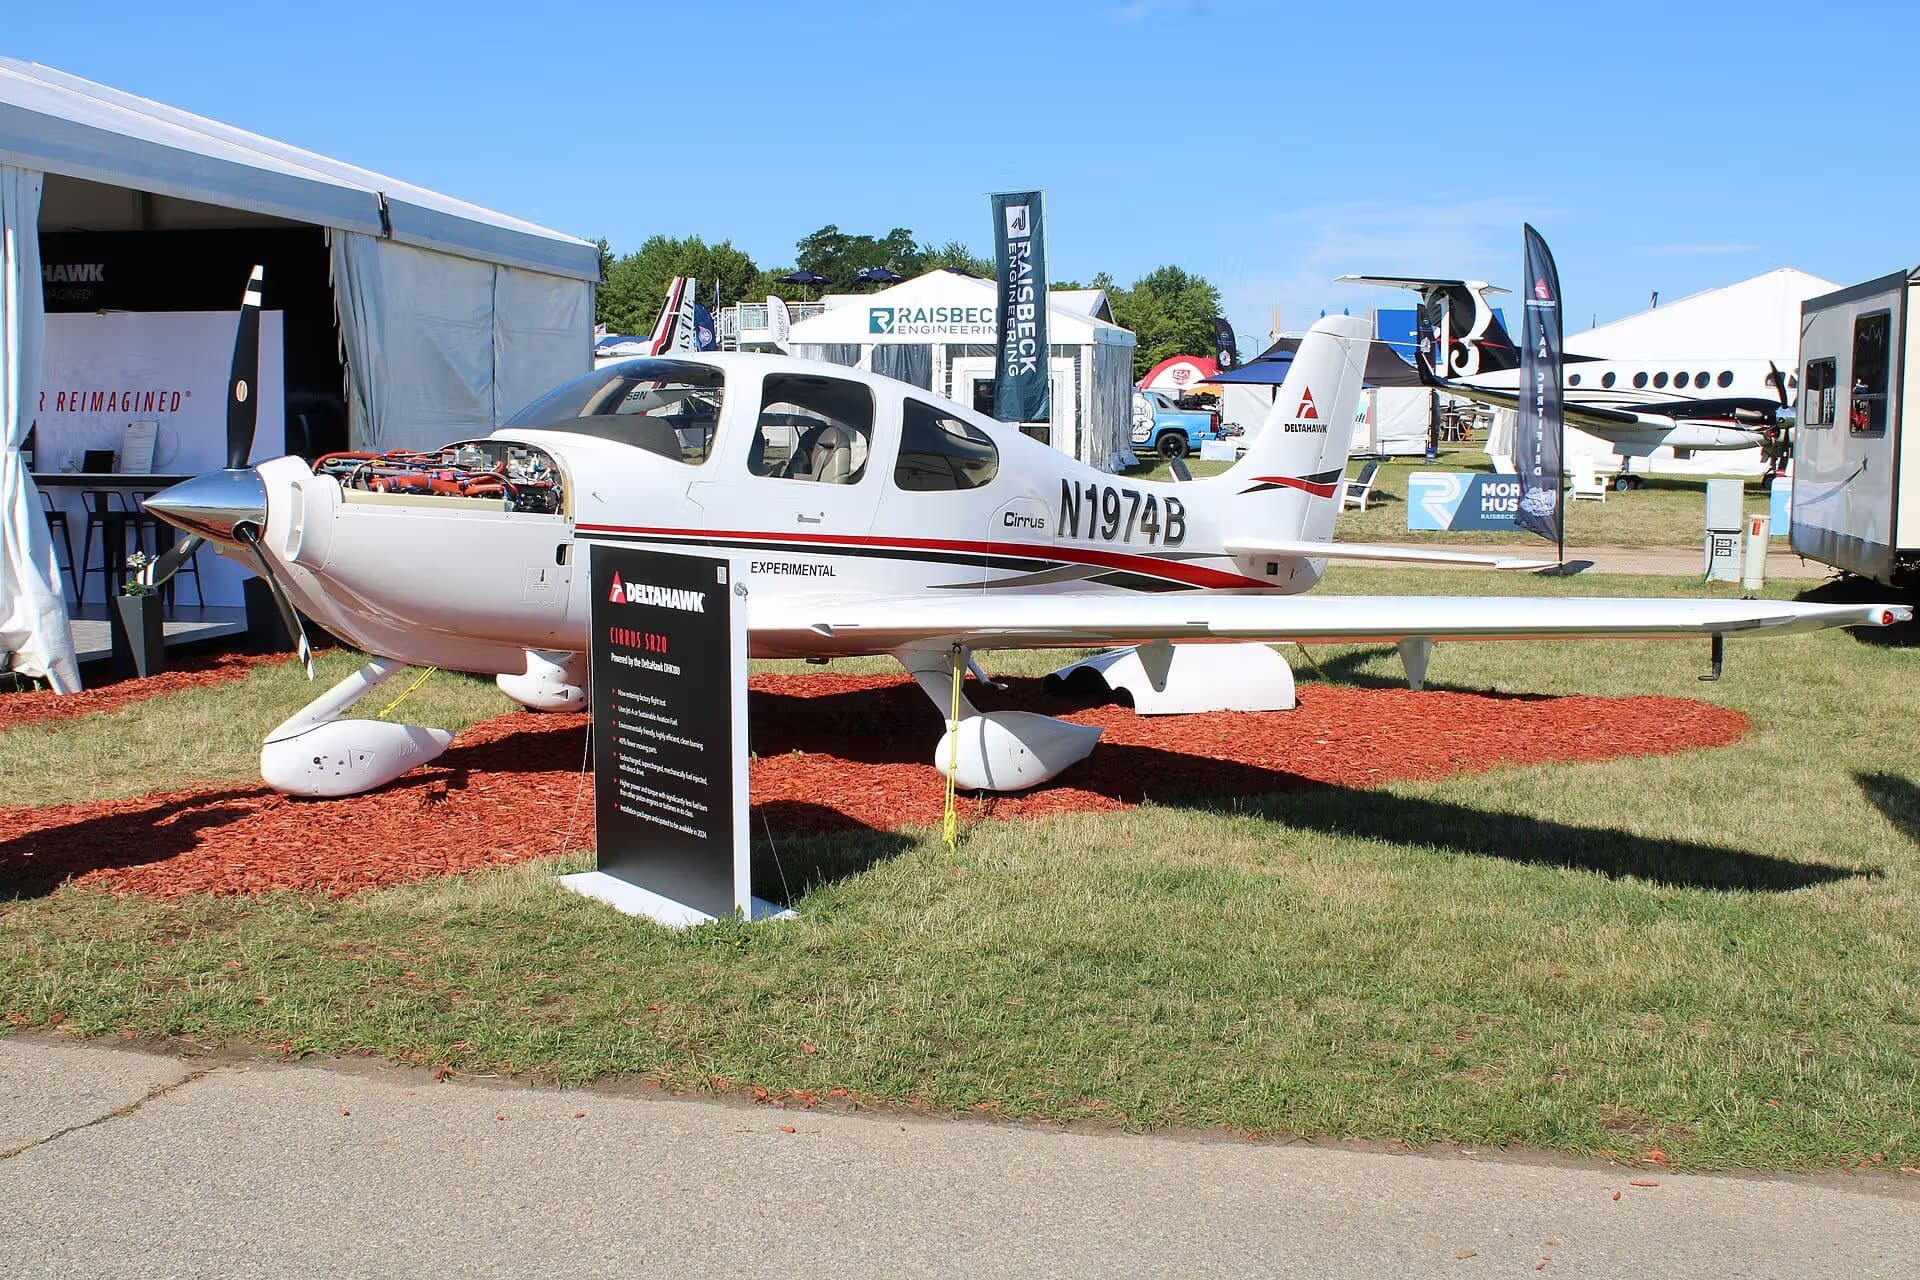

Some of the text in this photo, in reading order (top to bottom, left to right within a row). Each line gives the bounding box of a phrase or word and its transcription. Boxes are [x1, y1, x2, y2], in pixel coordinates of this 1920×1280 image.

[899, 307, 997, 323] RAISBEC
[1006, 243, 1019, 377] ENGINEERING
[1016, 241, 1036, 375] RAISBECK
[1284, 423, 1328, 433] DELTAHAWK
[1003, 511, 1045, 529] Cirrus
[1057, 478, 1187, 547] N1974B
[750, 561, 836, 577] EXPERIMENTAL
[624, 581, 705, 613] DELTAHAWK
[610, 626, 667, 653] CIRRUS SR20
